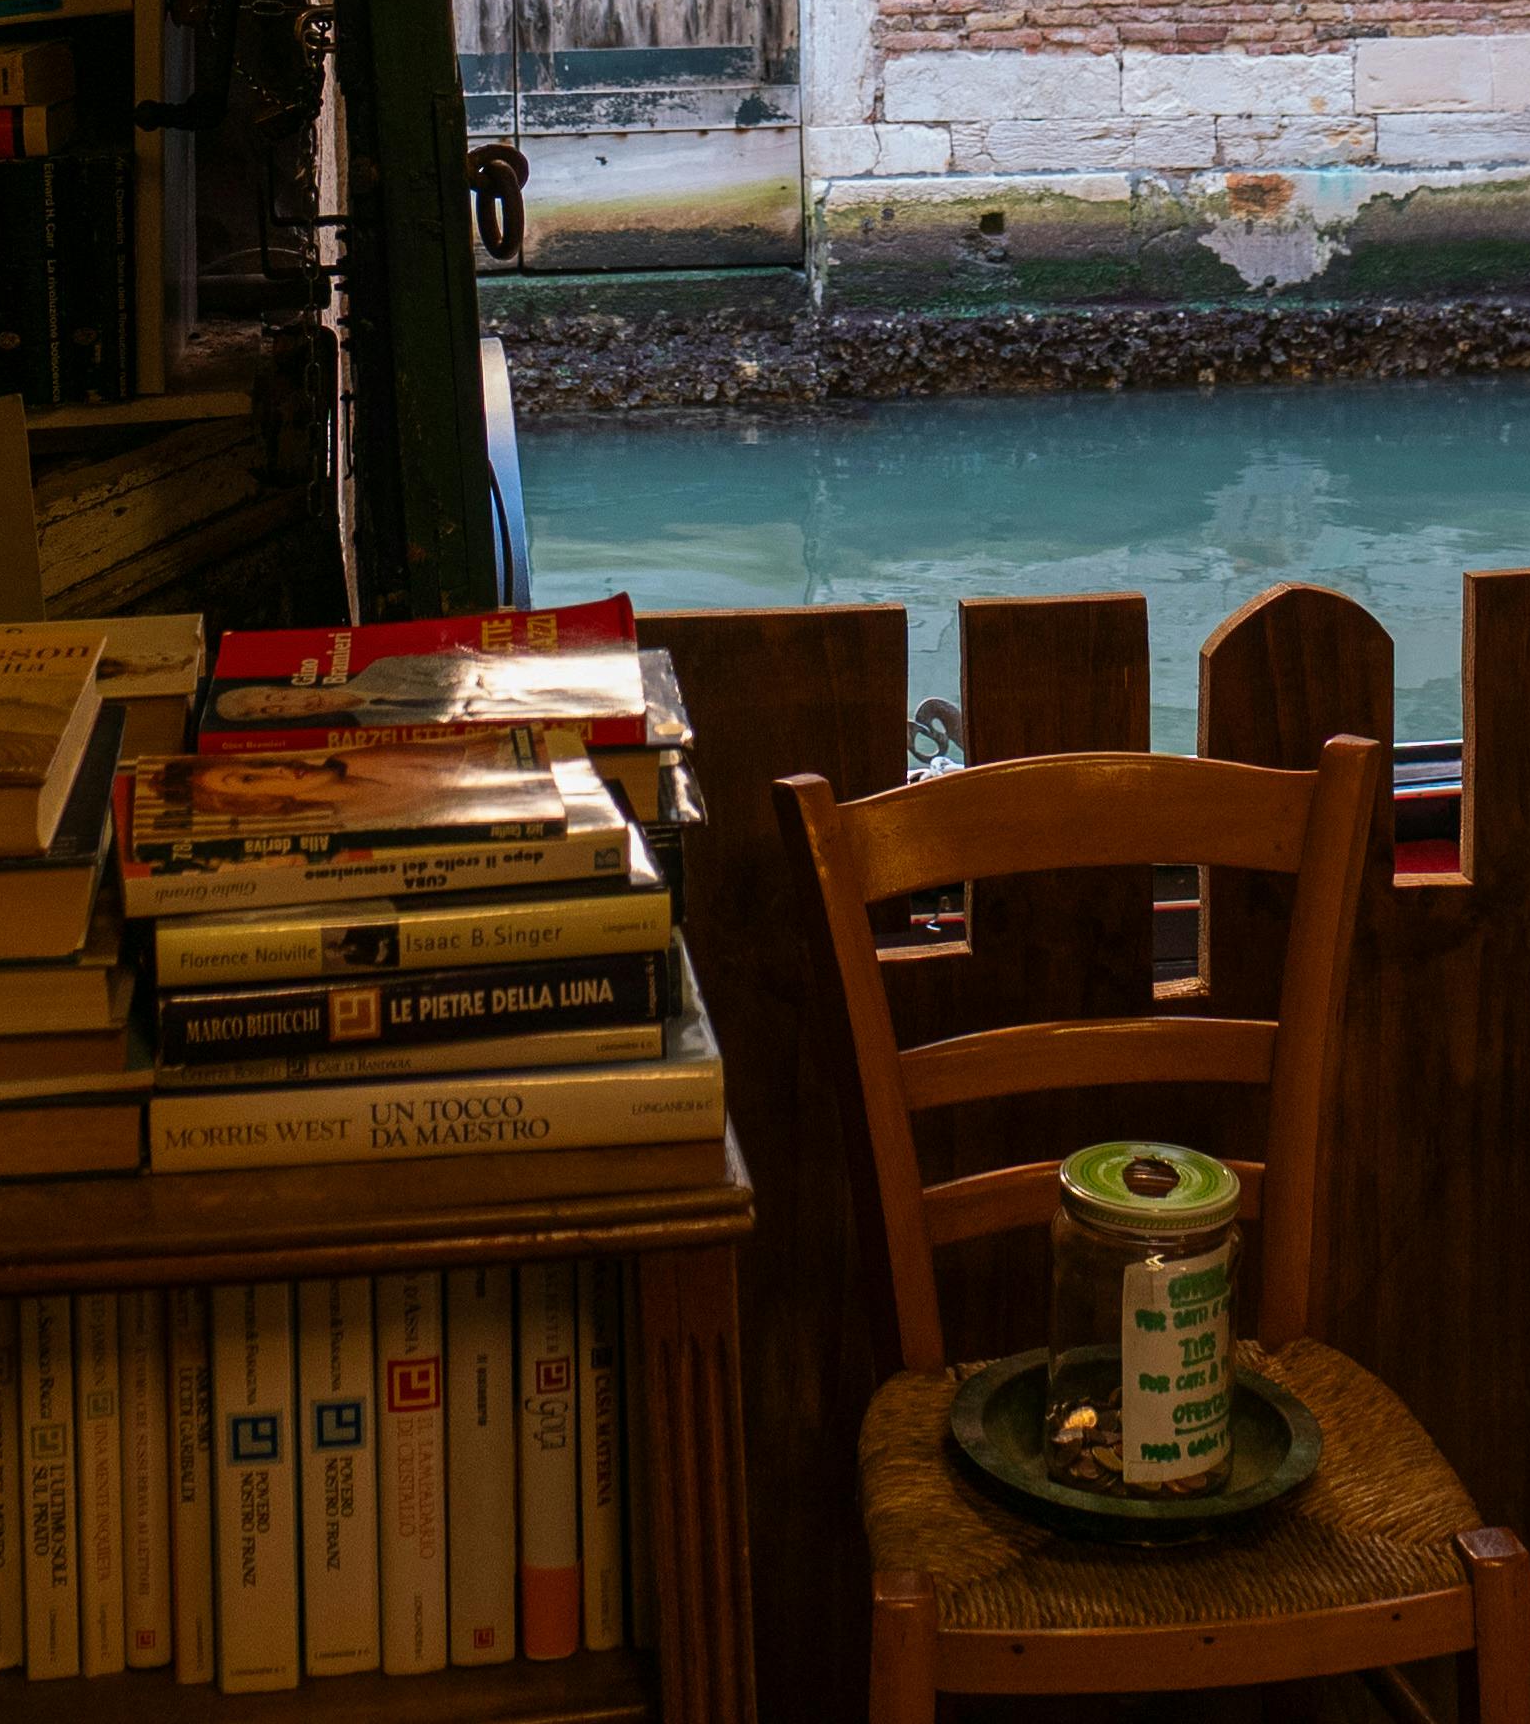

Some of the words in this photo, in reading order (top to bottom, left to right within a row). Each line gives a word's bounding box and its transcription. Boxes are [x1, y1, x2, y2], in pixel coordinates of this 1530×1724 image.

[290, 657, 319, 687] Gino
[243, 836, 291, 854] deriva
[296, 833, 329, 850] Alla
[502, 849, 544, 864] dopo
[303, 863, 397, 882] comunismo
[400, 860, 427, 875] del
[430, 855, 479, 871] crollo
[210, 880, 255, 897] Giulio
[403, 874, 447, 888] CUBA
[180, 947, 251, 970] Florence
[254, 943, 317, 965] Noiville
[404, 930, 460, 952] Isaac
[493, 923, 564, 952] Singer
[185, 1014, 244, 1044] MARCO
[245, 1007, 321, 1038] BUTICCHI
[389, 1000, 413, 1024] LE
[419, 994, 487, 1022] PIETRE
[492, 987, 553, 1014] DELLA
[558, 979, 614, 1006] LUNA
[368, 1102, 415, 1125] UN
[429, 1095, 524, 1119] TOCCO
[165, 1124, 269, 1152] MORRIS
[275, 1119, 352, 1141] WEST
[371, 1127, 409, 1150] DA
[415, 1118, 551, 1146] MAESTRO
[1178, 1330, 1217, 1360] TIPS
[595, 1376, 611, 1416] CASA
[179, 1420, 195, 1504] GARIBALDI
[595, 1424, 612, 1507] MATERNA
[31, 1466, 47, 1498] SUL
[324, 1458, 340, 1519] NOSTRO
[339, 1457, 354, 1518] POVERO
[240, 1473, 255, 1535] NOSTRO
[255, 1471, 269, 1534] POVERO
[417, 1443, 436, 1560] LAMPADARIO
[32, 1503, 49, 1557] PRATO
[325, 1521, 340, 1571] FRANZ
[242, 1536, 256, 1588] FRANZ
